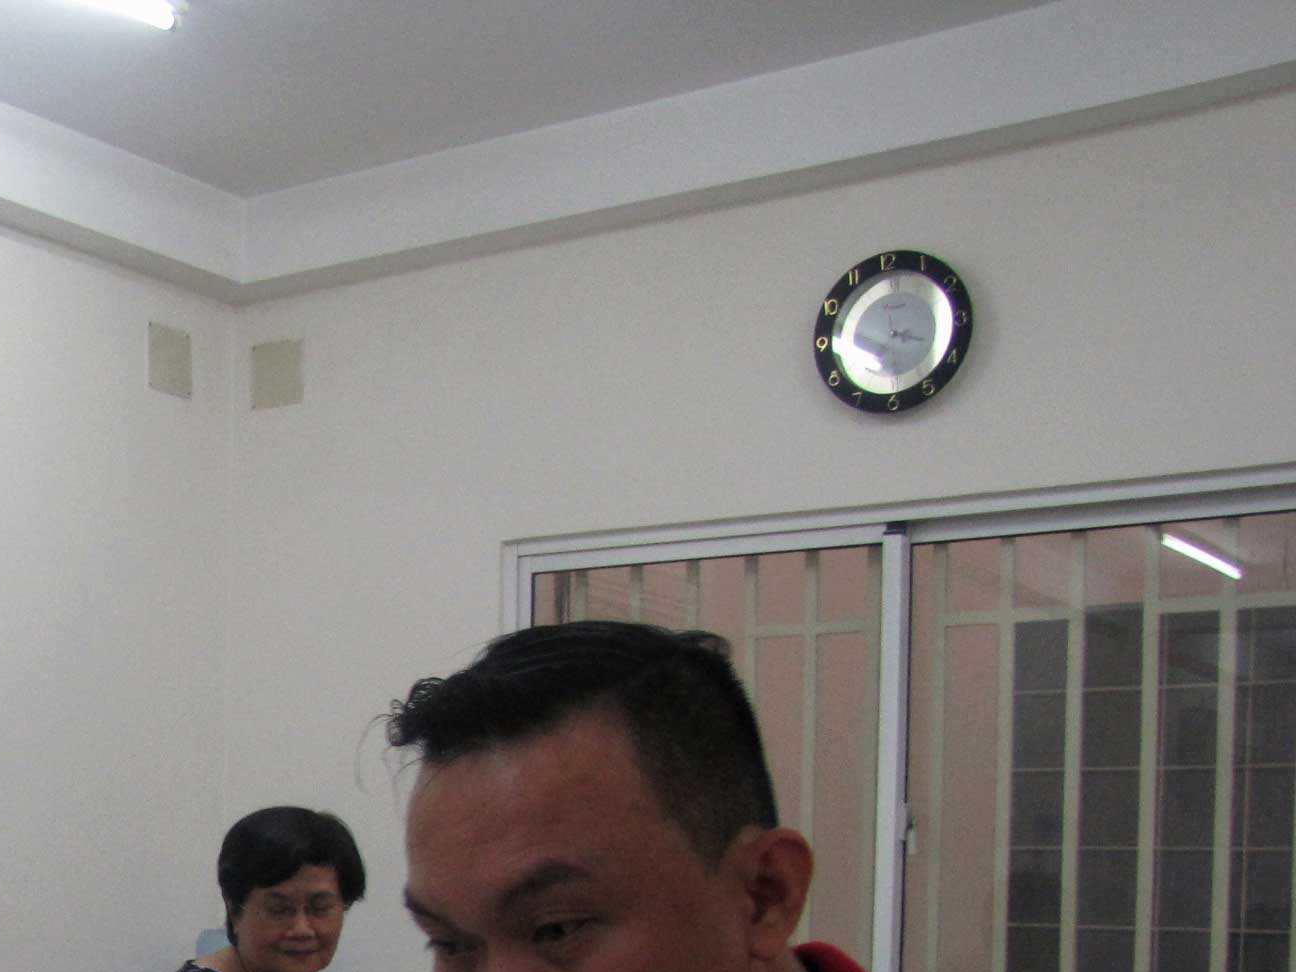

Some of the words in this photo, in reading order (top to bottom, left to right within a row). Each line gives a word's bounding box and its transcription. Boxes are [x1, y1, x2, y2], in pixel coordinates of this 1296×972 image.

[880, 254, 896, 272] 12
[920, 255, 926, 272] 1
[848, 269, 860, 286] 11
[943, 276, 958, 293] 2
[823, 298, 839, 316] 10
[816, 336, 829, 353] 9
[946, 349, 957, 365] 4
[828, 370, 841, 387] 8
[922, 379, 936, 397] 5
[851, 391, 862, 408] 7
[887, 394, 900, 411] 6
